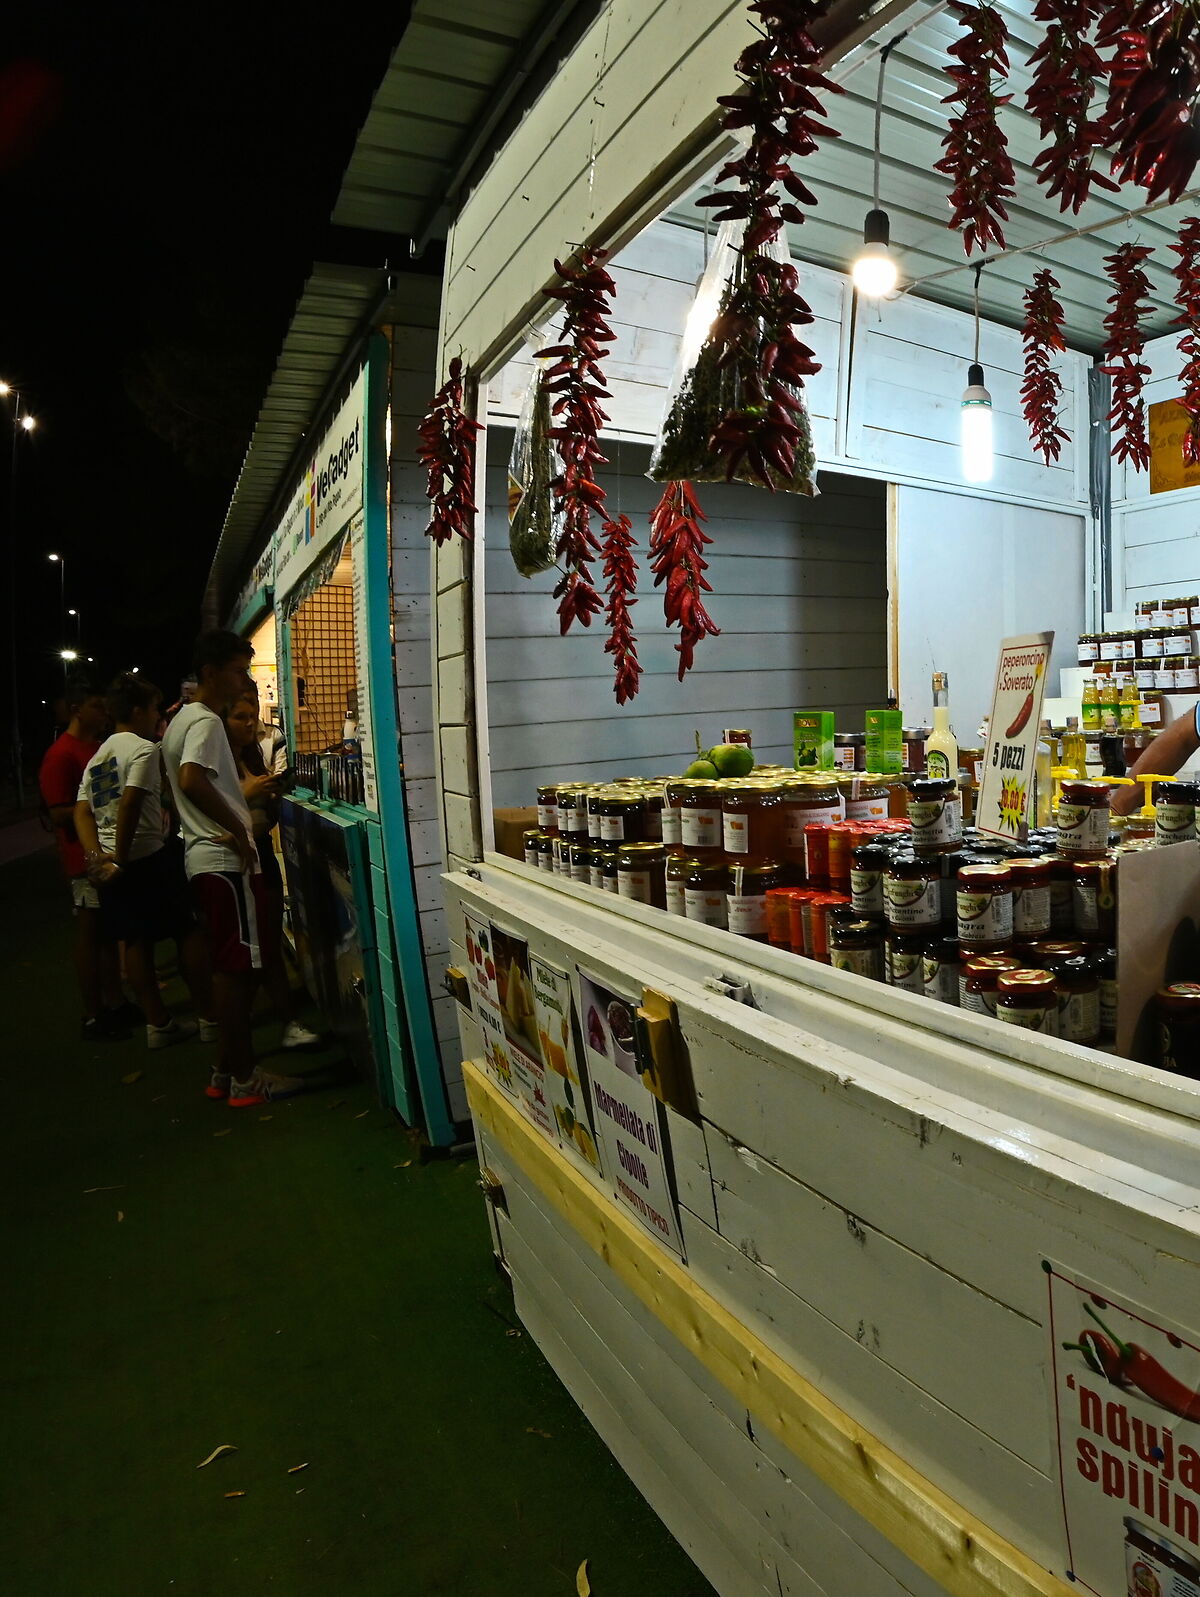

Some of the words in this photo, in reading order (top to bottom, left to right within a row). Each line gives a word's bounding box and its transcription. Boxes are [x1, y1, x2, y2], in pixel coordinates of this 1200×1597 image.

[1002, 650, 1045, 672] peperoncino
[1002, 672, 1034, 691] Soverato
[992, 742, 999, 767] 5
[1000, 744, 1026, 771] pezzi
[594, 1080, 646, 1146] Marmellata
[646, 1120, 658, 1155] di
[616, 1138, 649, 1190] Cipolle
